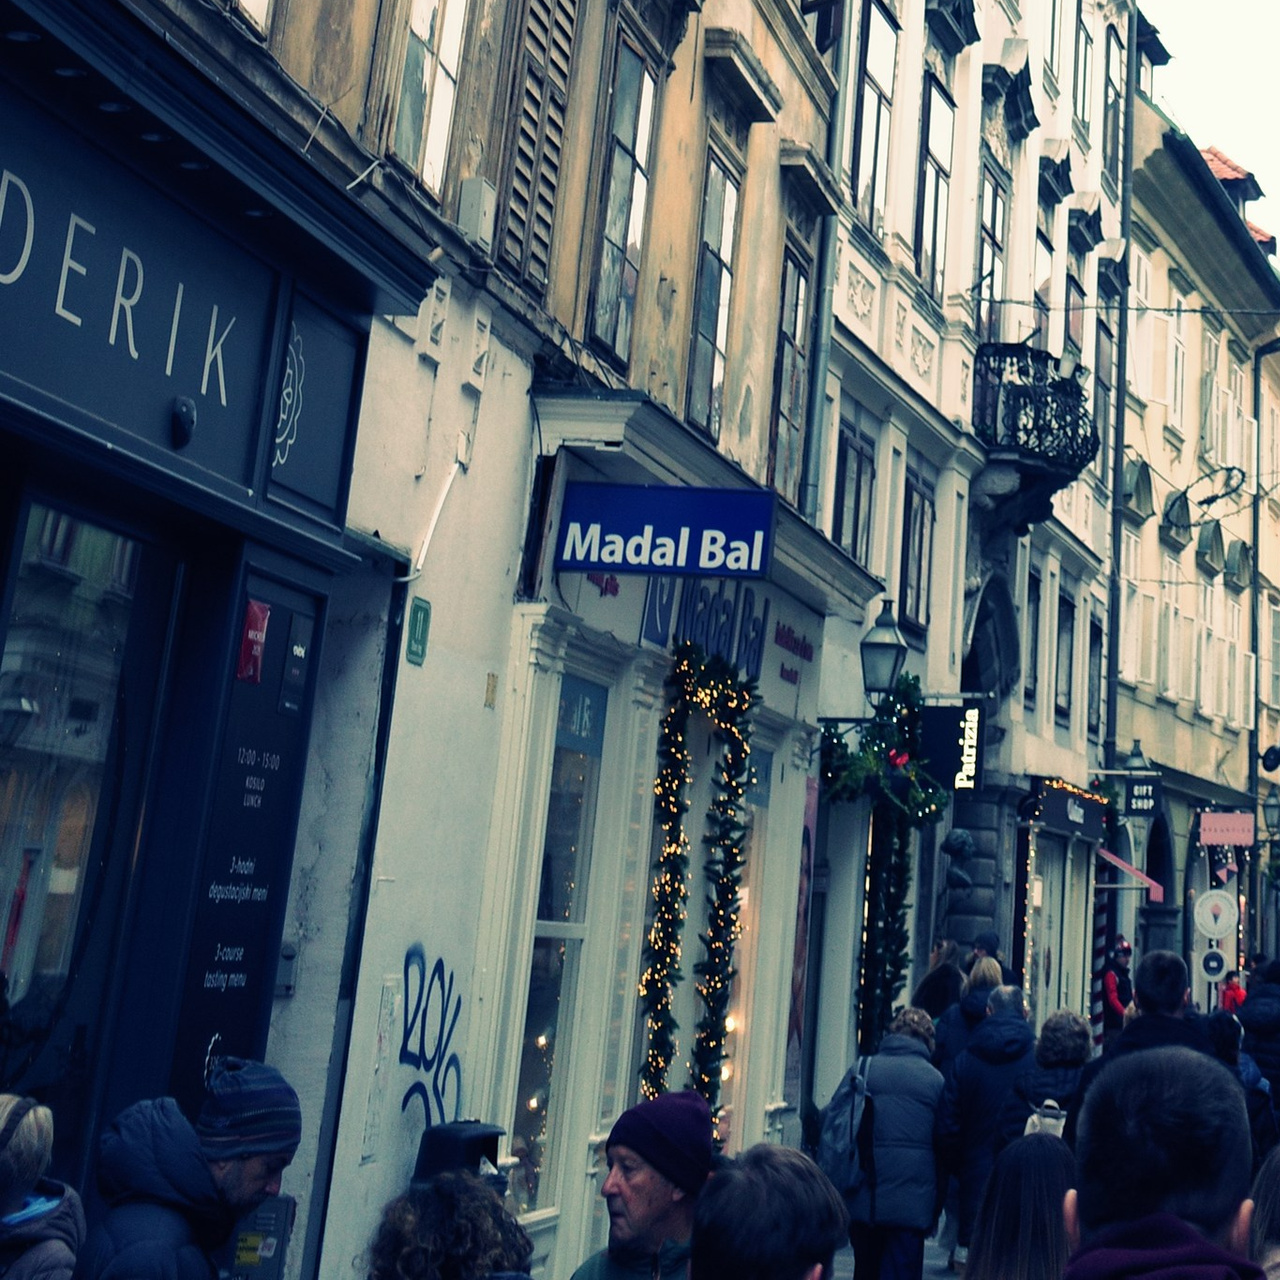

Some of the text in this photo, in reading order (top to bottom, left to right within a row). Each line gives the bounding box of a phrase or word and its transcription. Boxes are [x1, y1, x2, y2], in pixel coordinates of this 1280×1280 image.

[562, 521, 765, 572] Madal Bal
[954, 708, 979, 790] Patrizia
[262, 751, 281, 771] 15:00
[1132, 785, 1154, 797] GIFT
[243, 793, 262, 808] LUNCH
[1131, 798, 1155, 810] SHOP
[215, 943, 244, 961] 3-course
